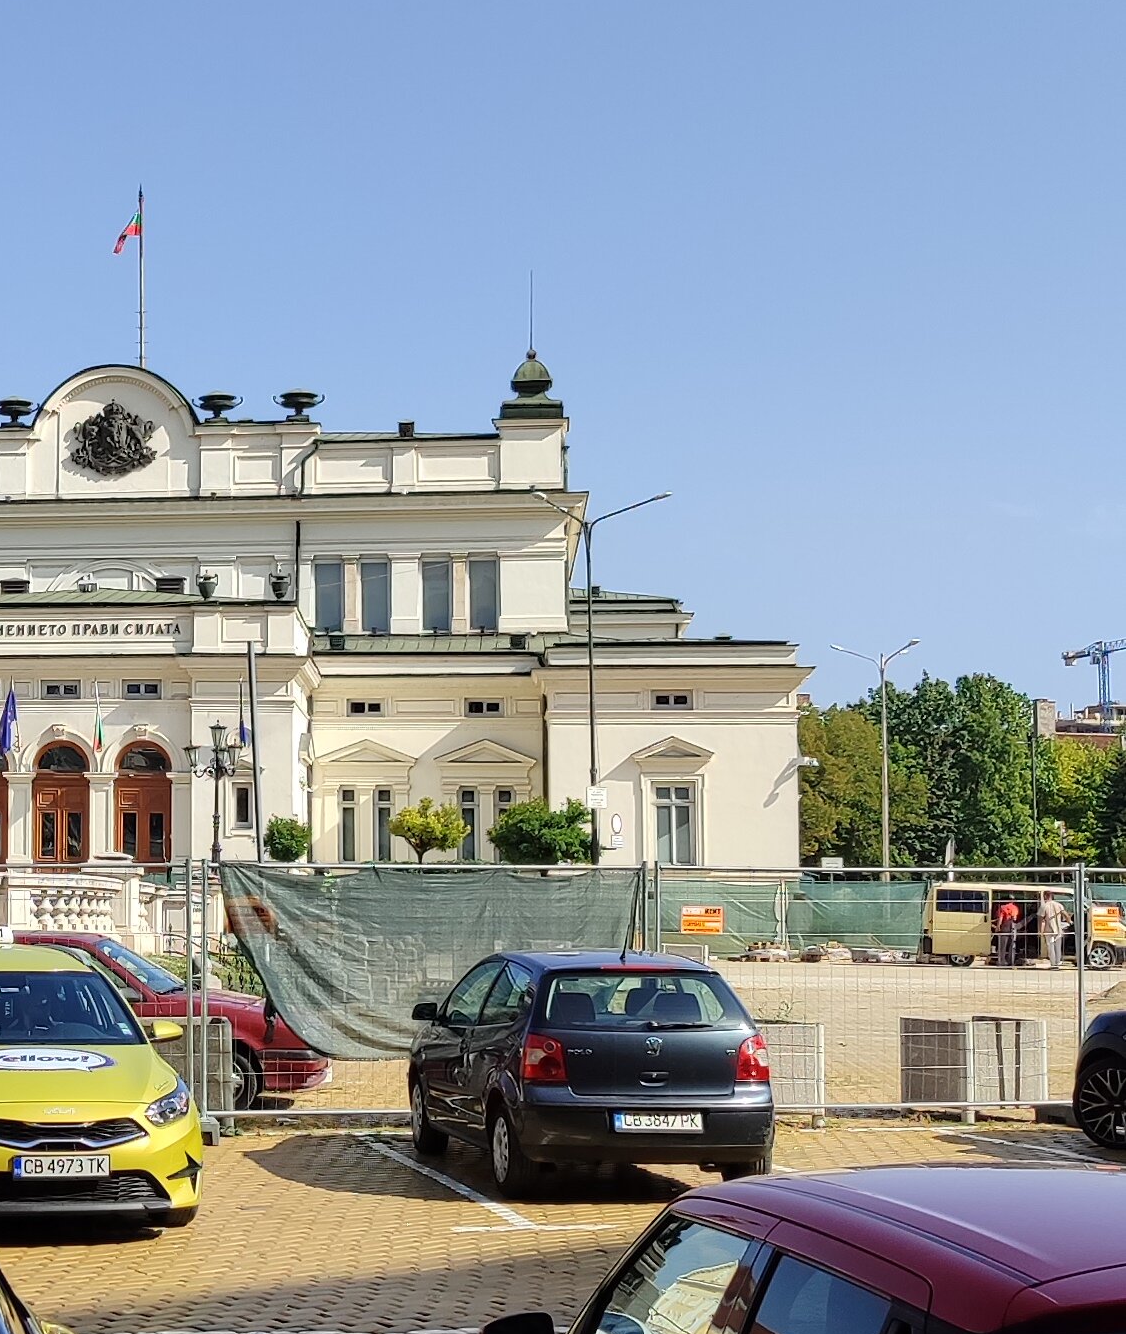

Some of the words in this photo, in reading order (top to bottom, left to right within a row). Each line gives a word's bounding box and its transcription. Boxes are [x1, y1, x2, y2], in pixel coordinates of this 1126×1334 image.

[72, 624, 119, 636] ПРАВИ
[124, 623, 181, 635] СИЛАТА
[24, 1159, 43, 1174] CB
[47, 1158, 84, 1174] 4973
[87, 1157, 106, 1174] TK
